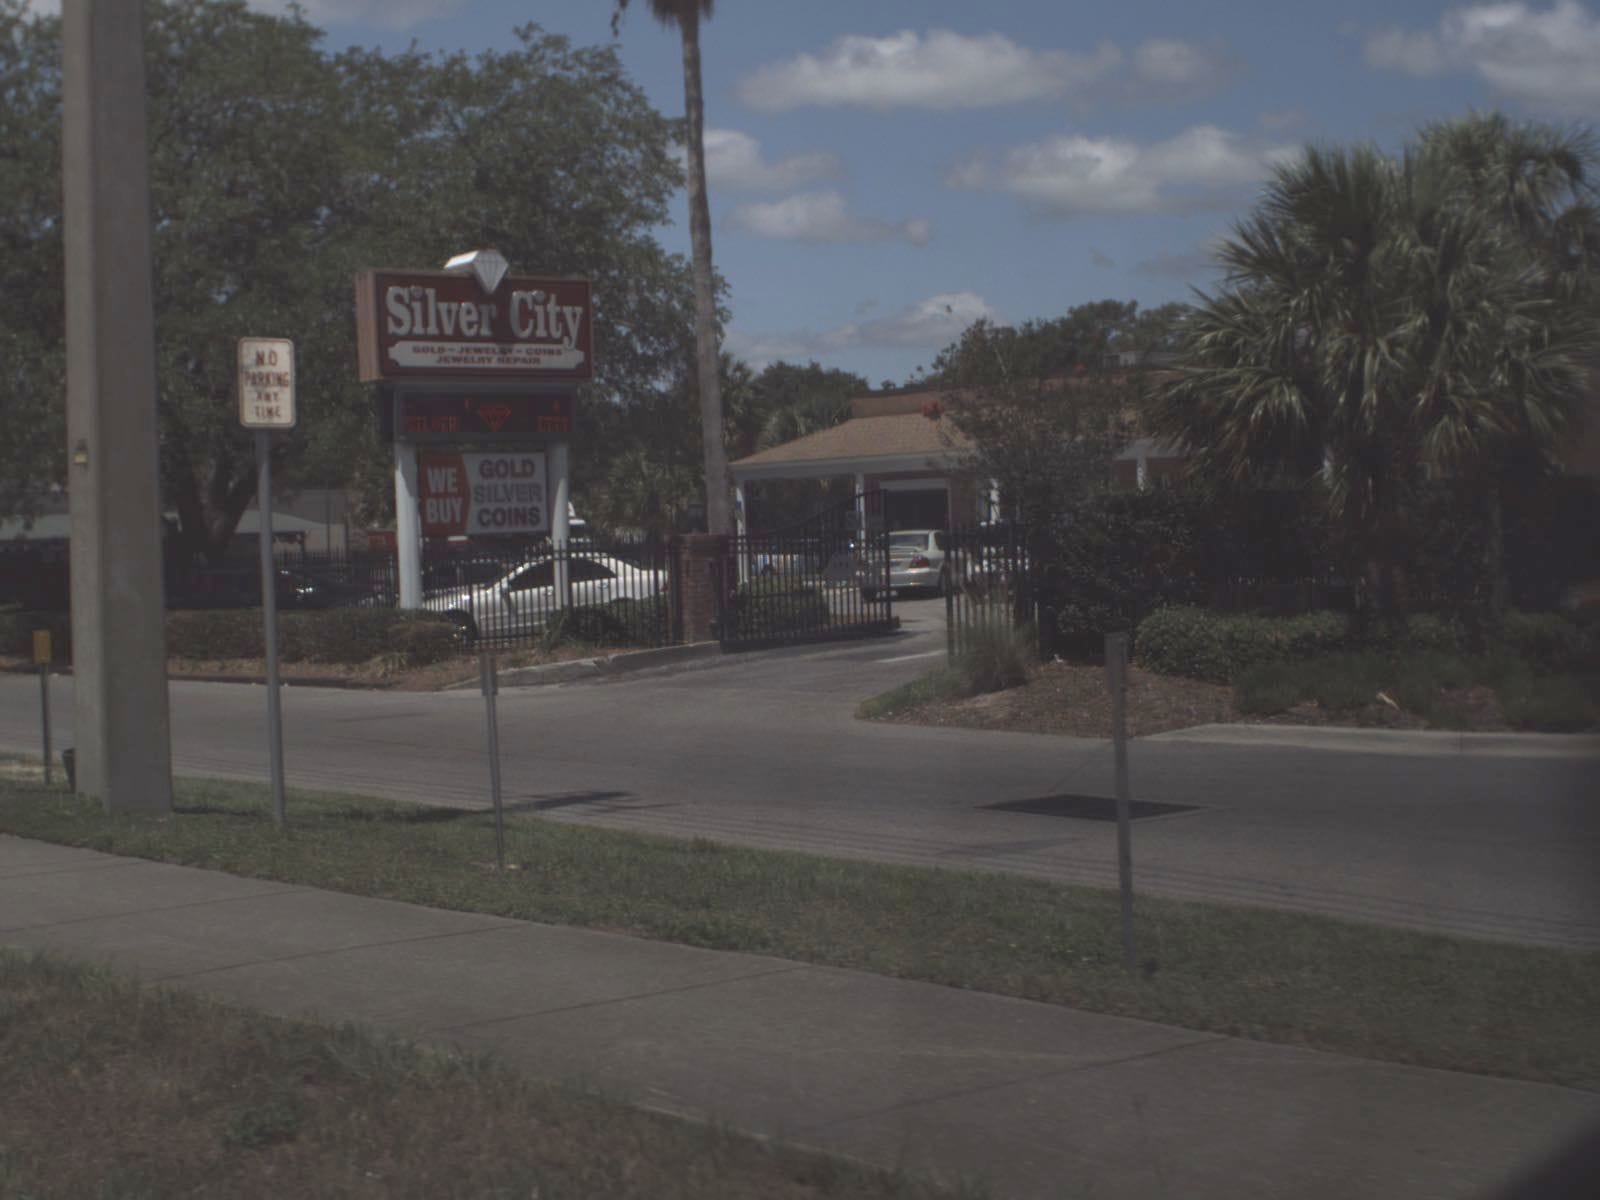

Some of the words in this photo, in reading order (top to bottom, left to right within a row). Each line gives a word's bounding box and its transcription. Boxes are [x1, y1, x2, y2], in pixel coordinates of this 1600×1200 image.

[386, 285, 496, 336] Silver
[510, 290, 583, 349] City
[255, 350, 278, 366] NO
[412, 345, 446, 355] GOLD
[526, 347, 563, 357] COINS
[436, 356, 493, 365] JEWELRY
[497, 356, 541, 366] REPAIR
[255, 406, 281, 417] TIME
[479, 458, 535, 479] GOLD
[427, 467, 458, 493] WE
[474, 482, 542, 504] SILVER
[426, 497, 463, 524] BUY
[477, 506, 541, 527] COINS
